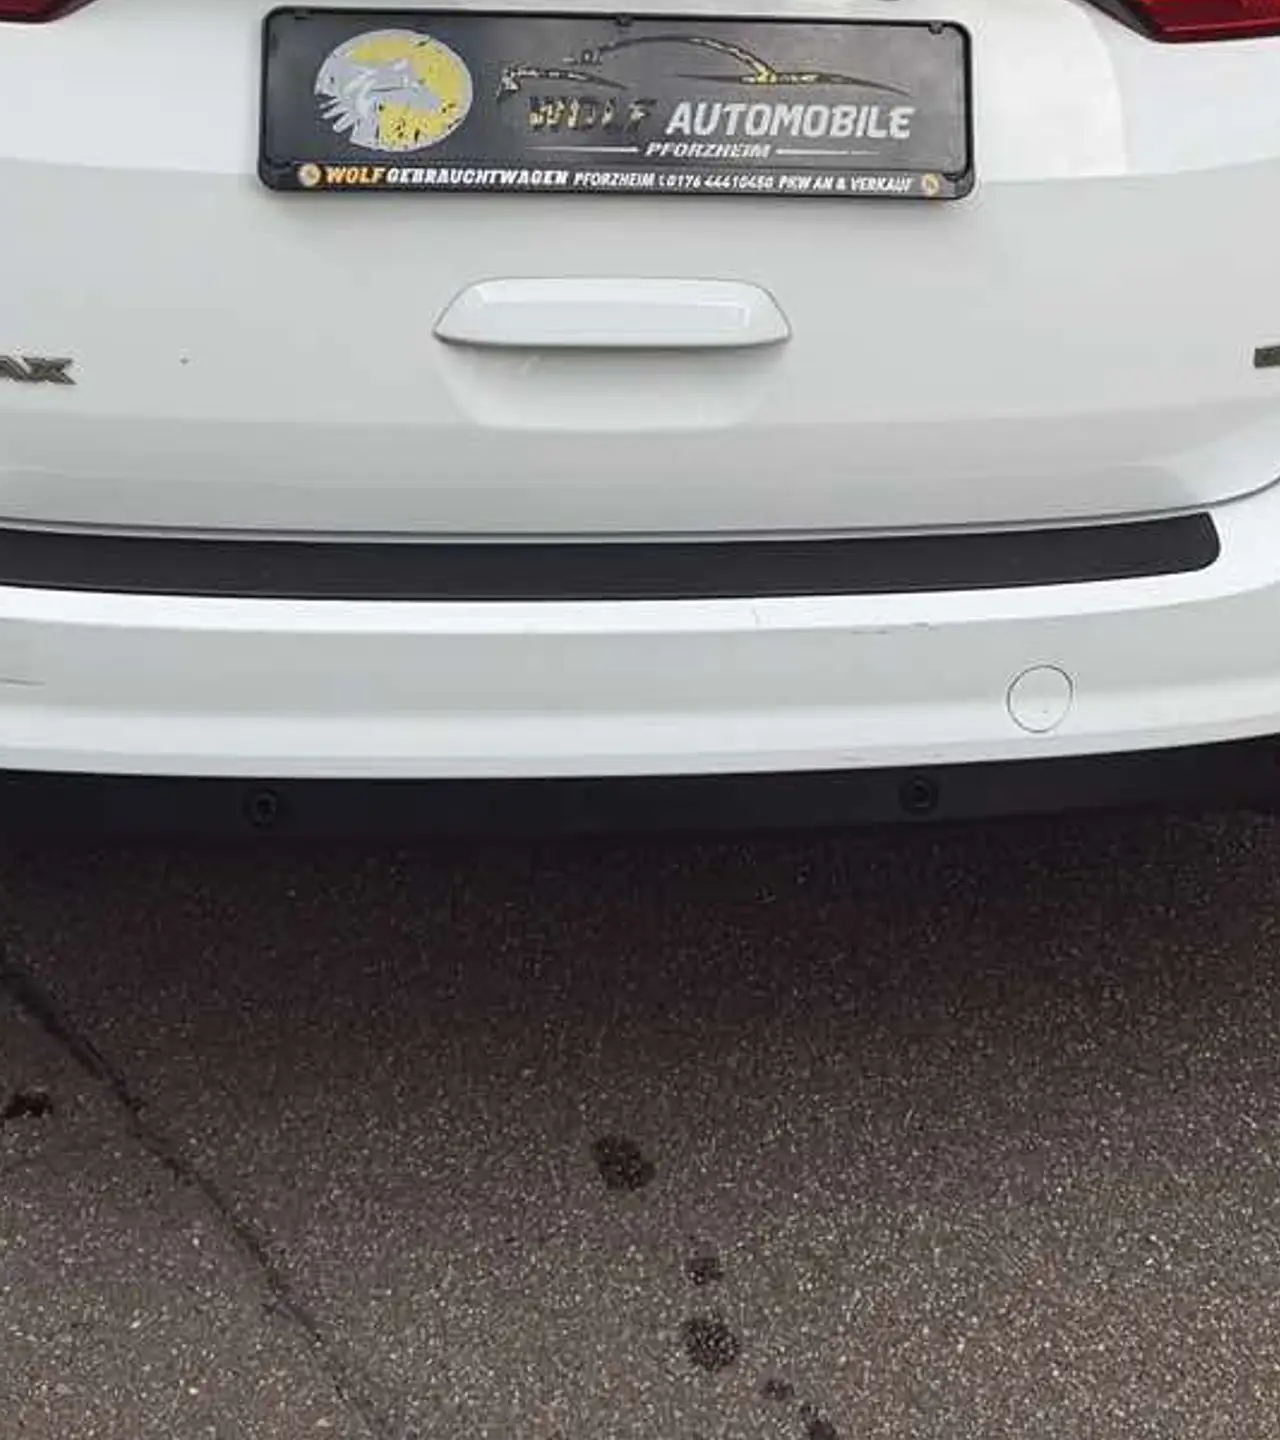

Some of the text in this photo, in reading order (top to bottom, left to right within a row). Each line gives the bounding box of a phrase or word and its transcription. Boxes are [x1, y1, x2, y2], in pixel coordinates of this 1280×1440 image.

[665, 102, 917, 139] AUTOMOBILE
[644, 141, 772, 160] PFORZHEIM
[325, 167, 385, 185] WOLF
[386, 167, 568, 187] GEBRAUCHTWAGEN
[573, 170, 655, 188] PFORZHEIM
[851, 174, 914, 195] VERKAUF
